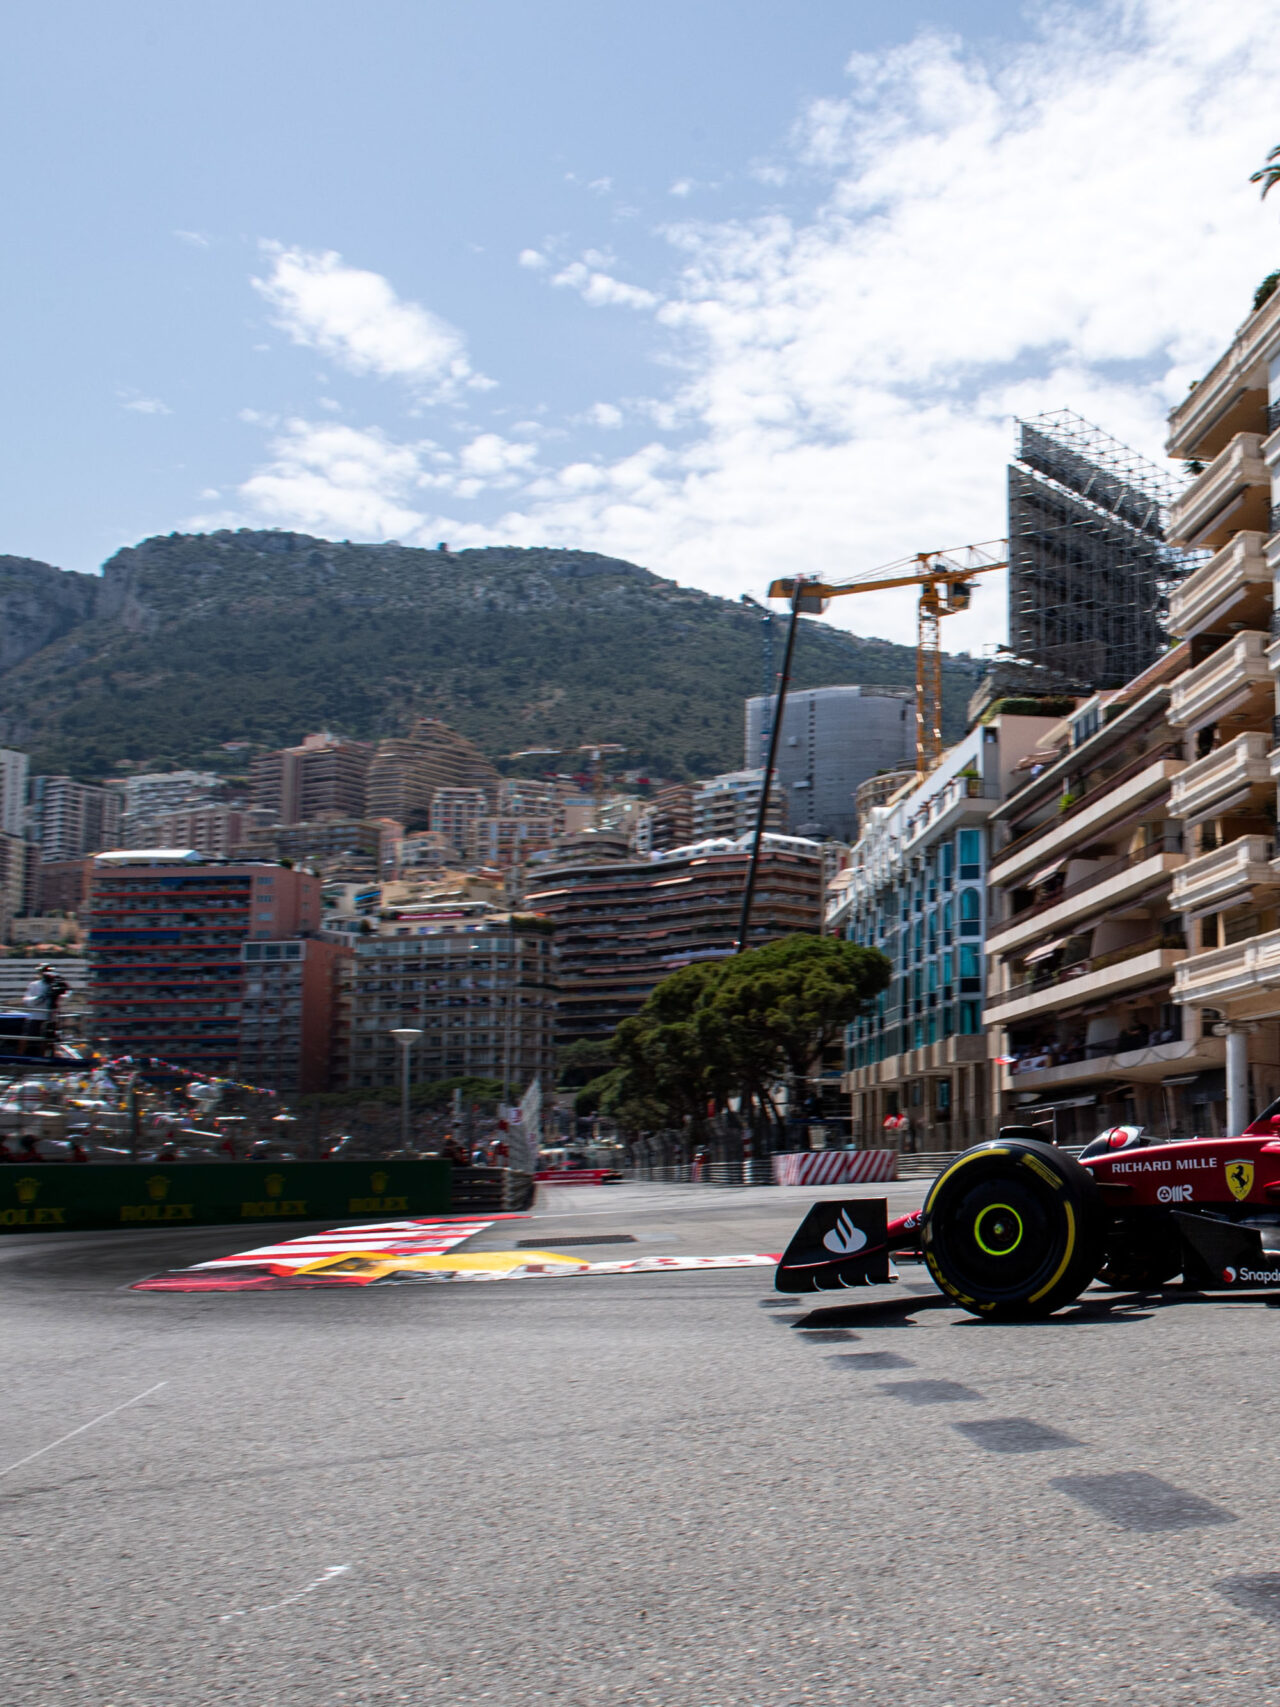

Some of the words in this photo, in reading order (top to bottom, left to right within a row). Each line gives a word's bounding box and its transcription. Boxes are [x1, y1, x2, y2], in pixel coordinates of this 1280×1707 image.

[1111, 1160, 1172, 1174] RICHARD
[1176, 1157, 1218, 1170] MILLE
[0, 1208, 66, 1226] OLEX
[120, 1203, 194, 1222] ROLEX
